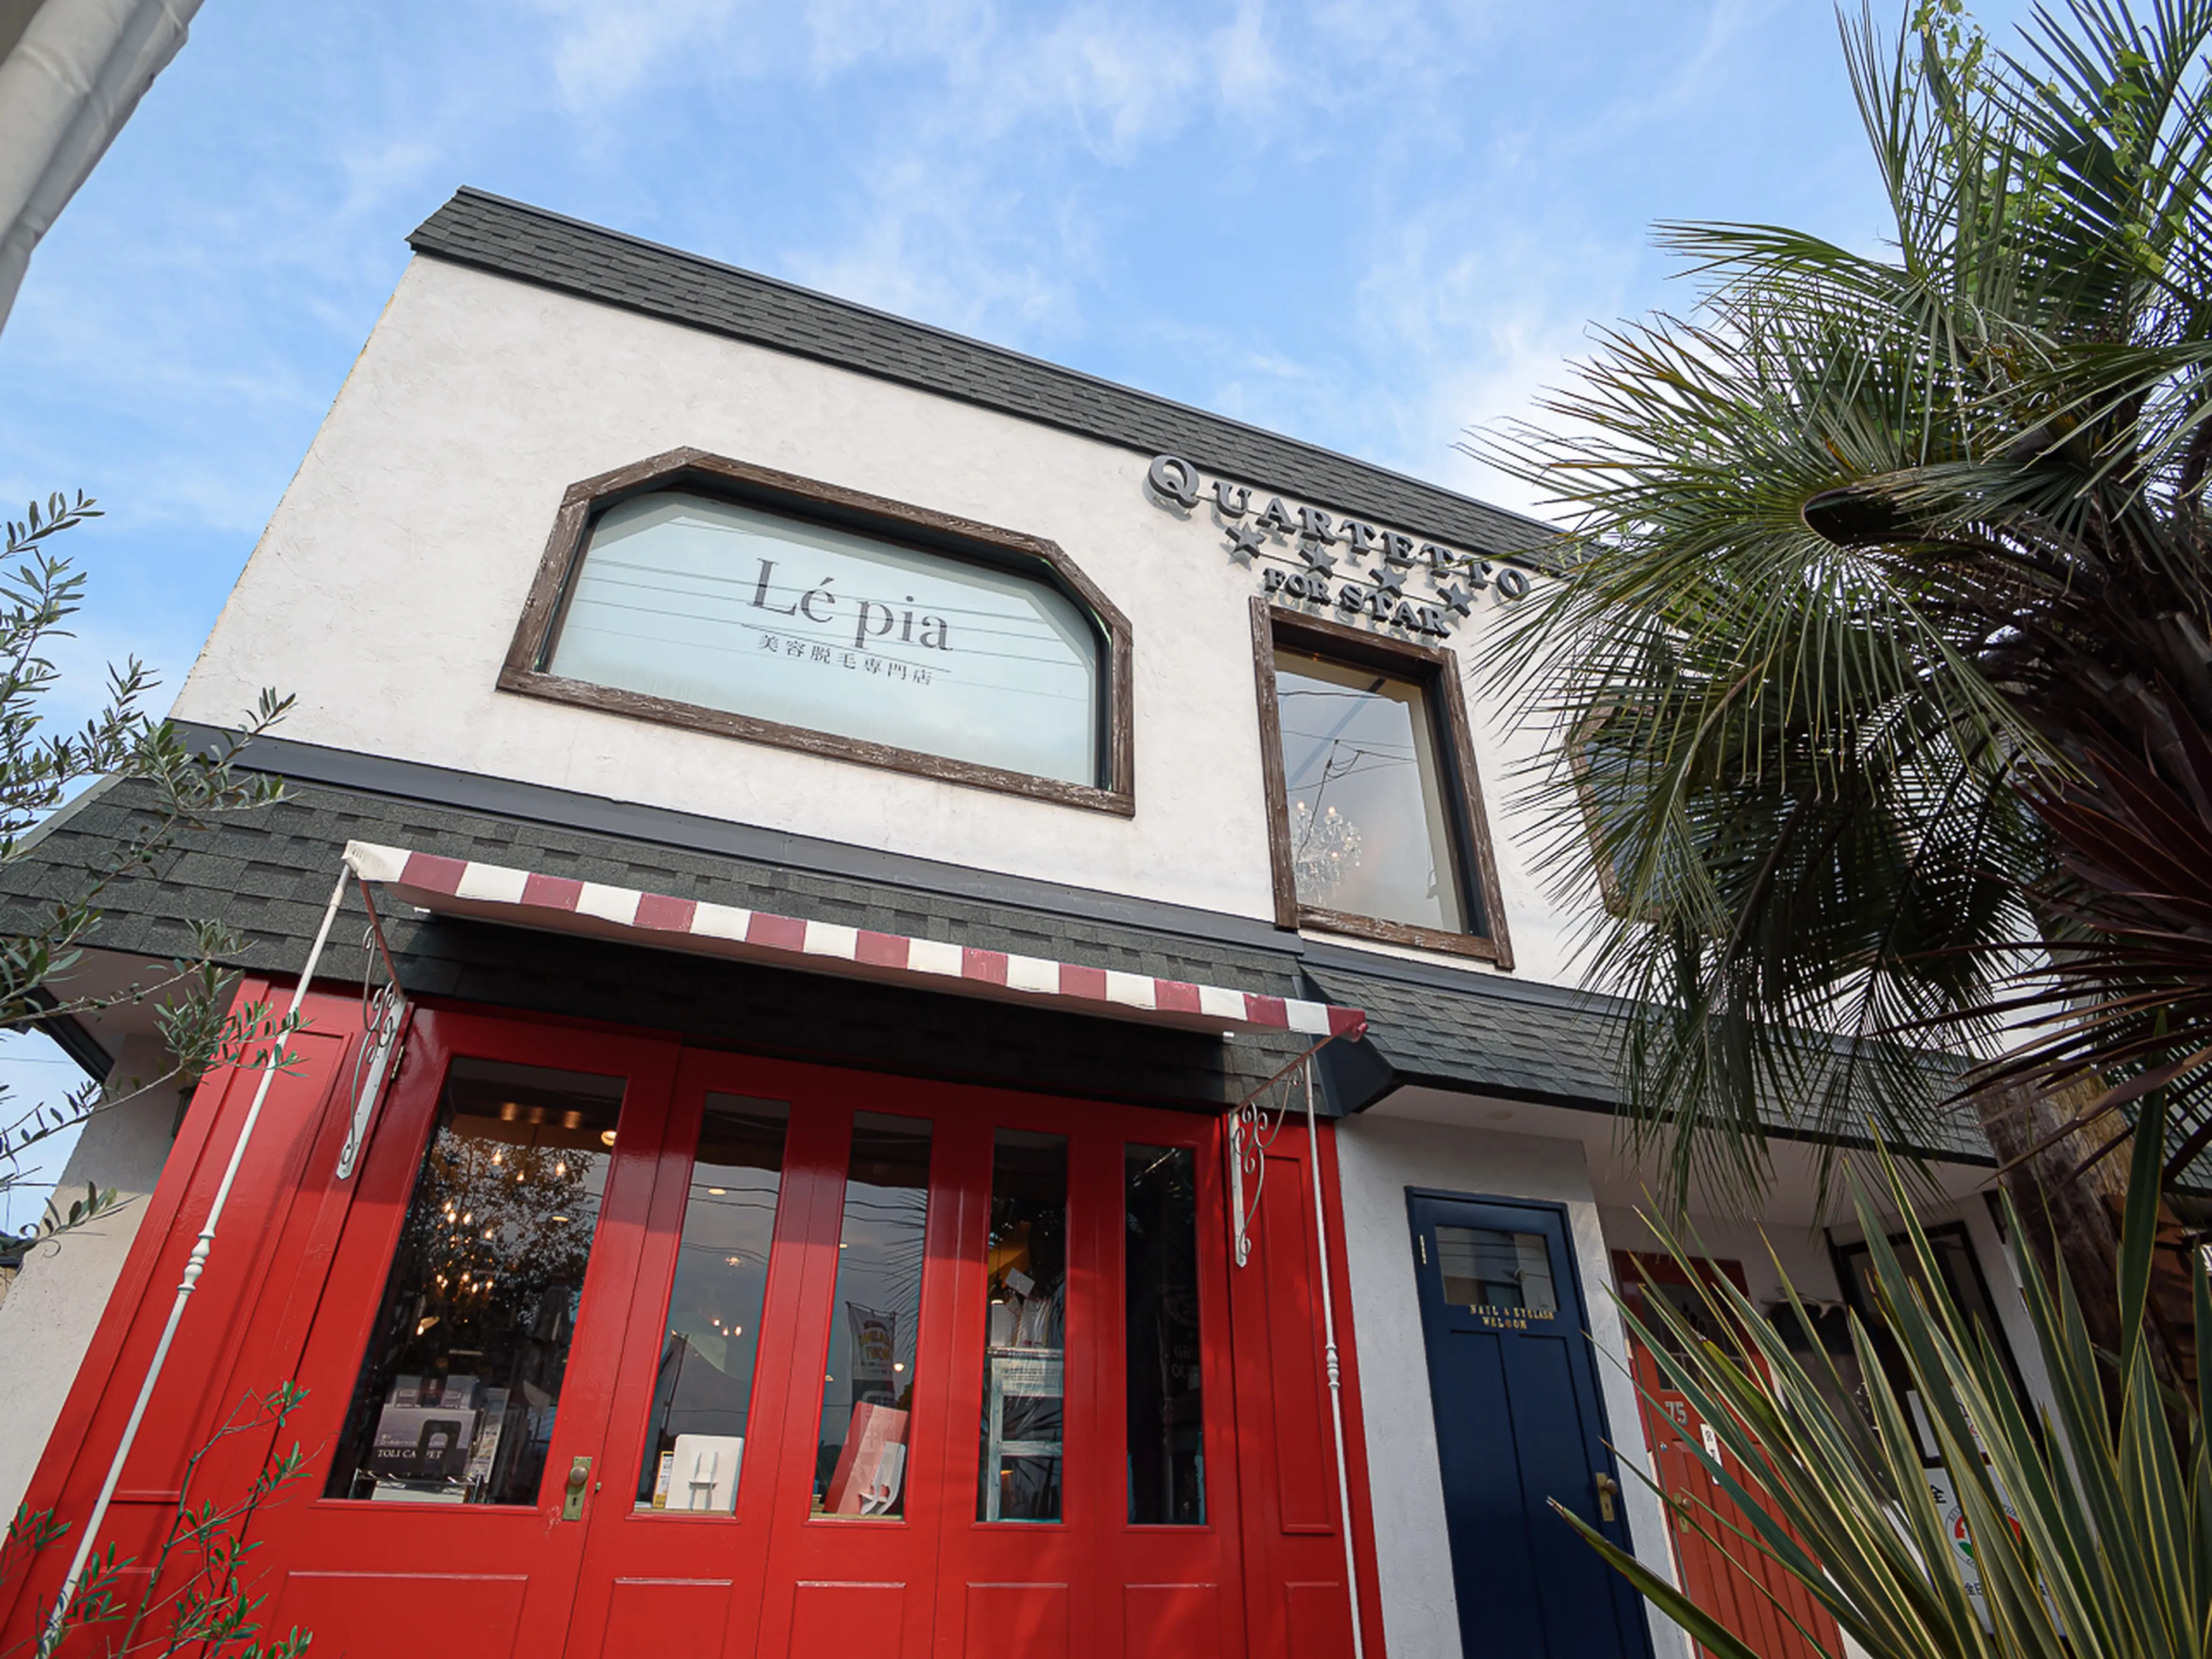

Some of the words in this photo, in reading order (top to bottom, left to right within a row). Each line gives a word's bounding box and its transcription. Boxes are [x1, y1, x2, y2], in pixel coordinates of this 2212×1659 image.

[1145, 454, 1532, 601] QUARTETTO
[748, 558, 836, 623] Lé
[851, 595, 953, 651] pia
[1263, 567, 1332, 606] FOR
[1339, 584, 1452, 639] STAR
[758, 634, 933, 686] 美容脱毛専門店
[1470, 1304, 1499, 1316] NAIL
[1513, 1307, 1555, 1320] EYELASH
[1664, 1400, 1688, 1426] 75
